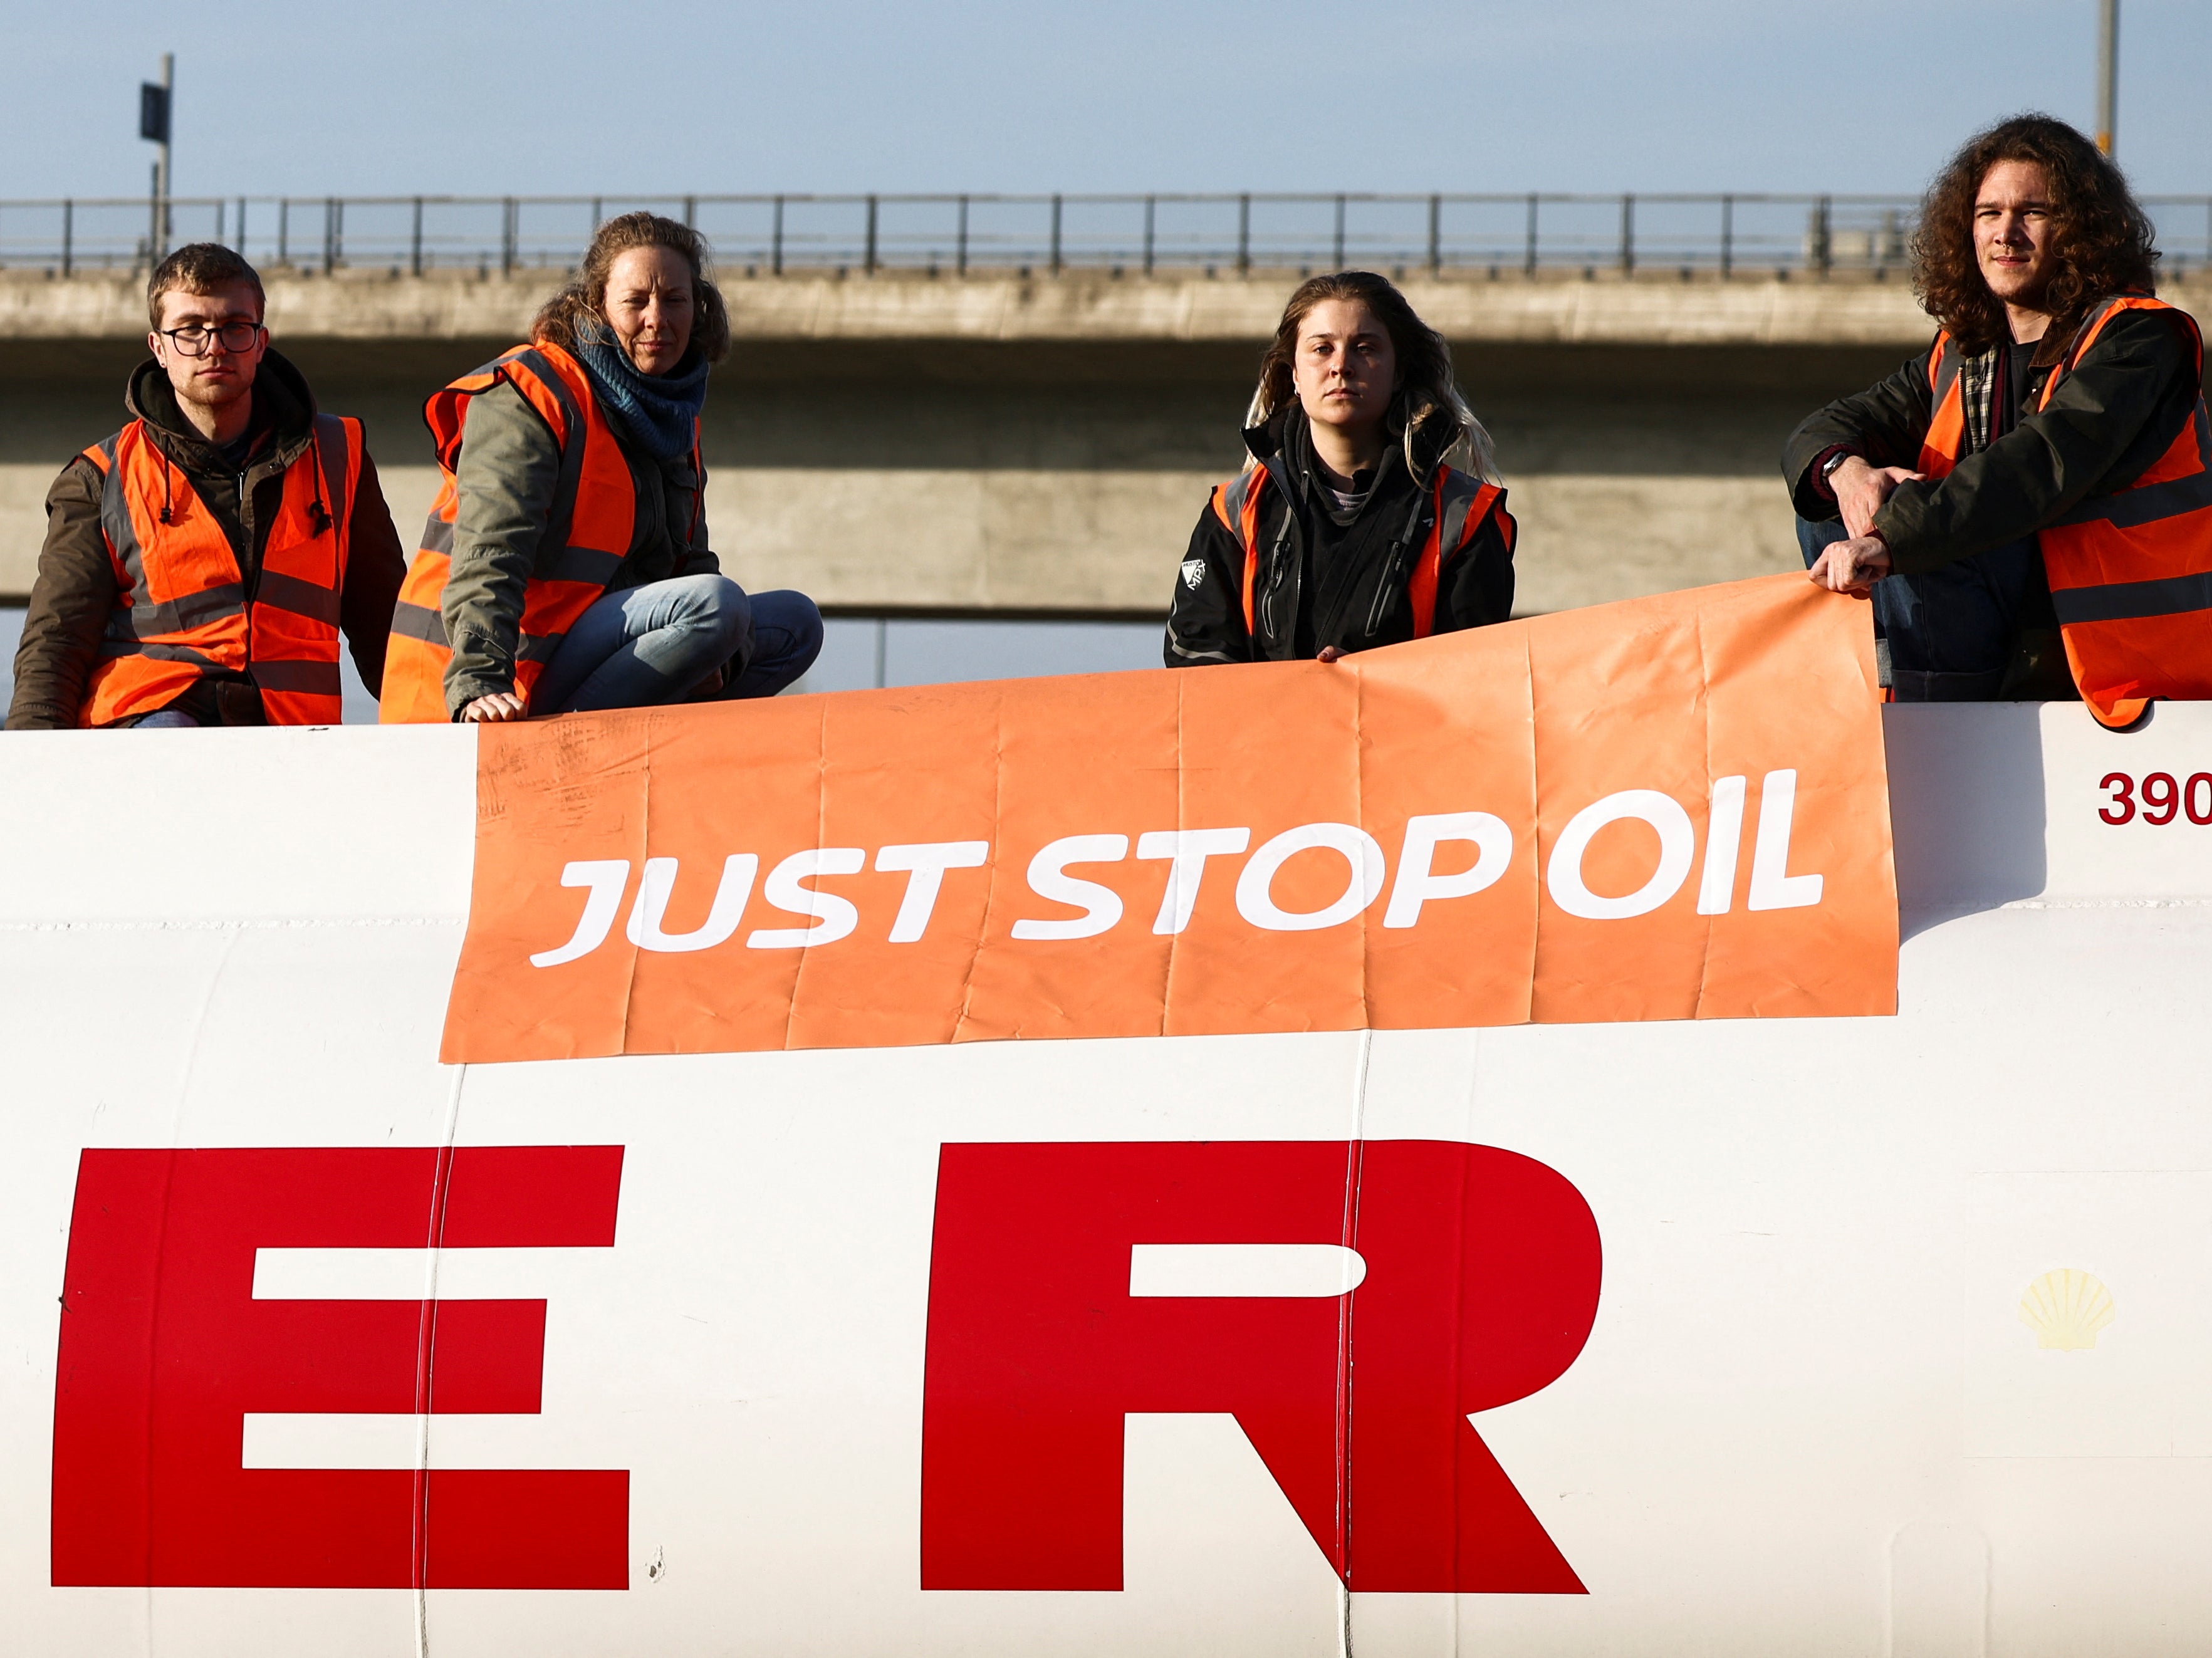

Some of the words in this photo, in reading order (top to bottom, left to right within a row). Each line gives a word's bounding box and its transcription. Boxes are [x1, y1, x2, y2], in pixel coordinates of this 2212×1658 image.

[1187, 559, 1206, 590] MPX
[2098, 772, 2212, 825] 390
[530, 840, 989, 967] JUST
[1011, 811, 1513, 940] STOP
[1547, 768, 1823, 920] OIL
